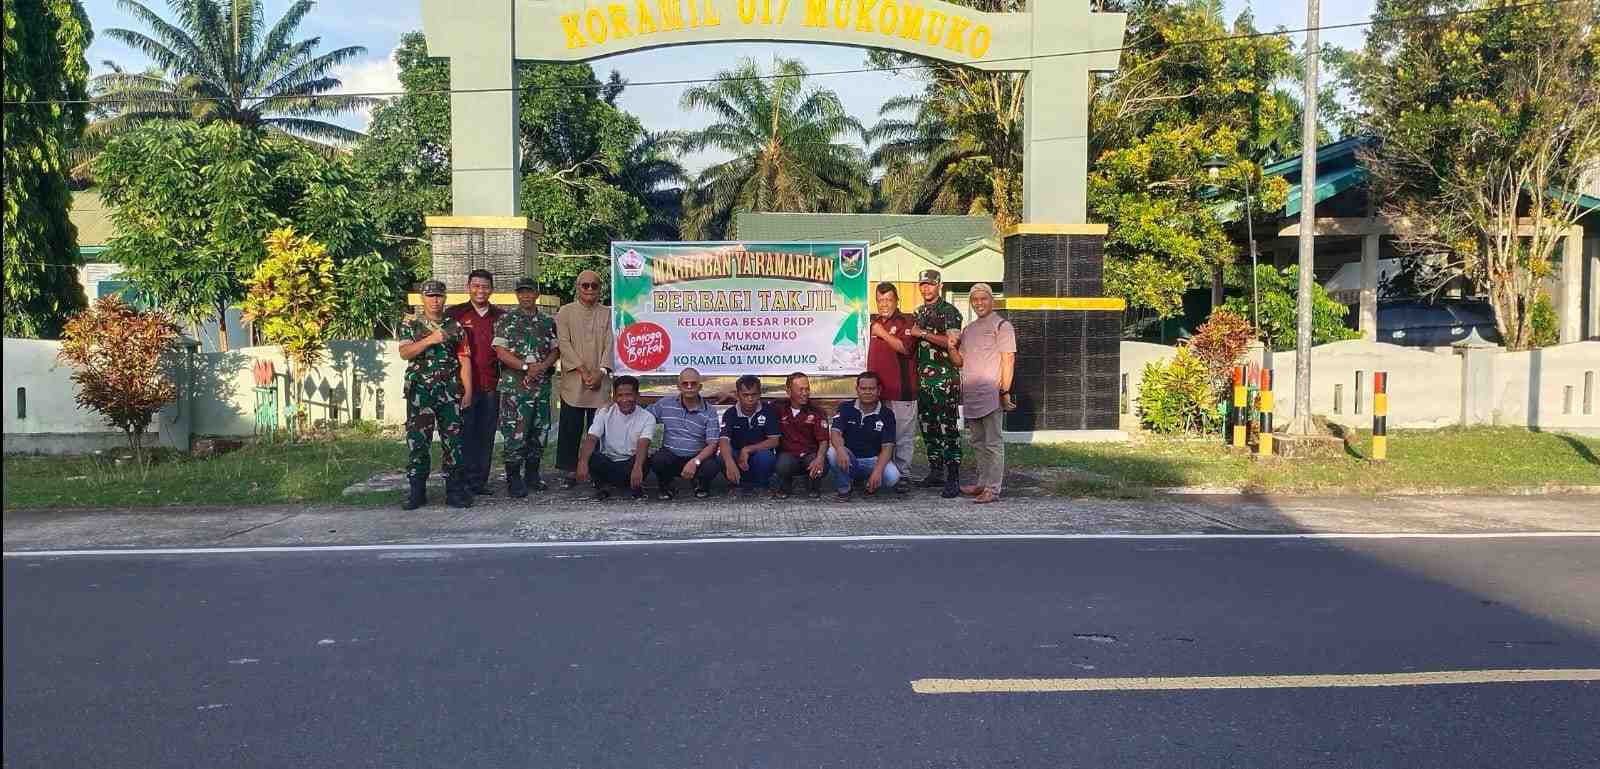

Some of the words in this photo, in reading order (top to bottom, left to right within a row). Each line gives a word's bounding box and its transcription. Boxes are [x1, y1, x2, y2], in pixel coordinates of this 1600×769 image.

[560, 0, 720, 49] KORAMIL
[799, 0, 992, 58] MUKOMUKO
[653, 249, 733, 285] MARHABAN
[754, 251, 834, 285] RAMADHAN
[653, 290, 752, 312] BERBAGI
[758, 290, 837, 312] TAKJIL
[677, 317, 738, 327] KELUARGA
[743, 317, 779, 326] BESAR
[783, 317, 814, 326] PKDP
[691, 331, 720, 341] KOTA
[725, 331, 797, 340] MUKOMUKO
[721, 341, 766, 351] Bersama
[673, 355, 726, 365] KORAMIL
[729, 355, 742, 365] 01
[746, 355, 817, 365] MUKOMUKO
